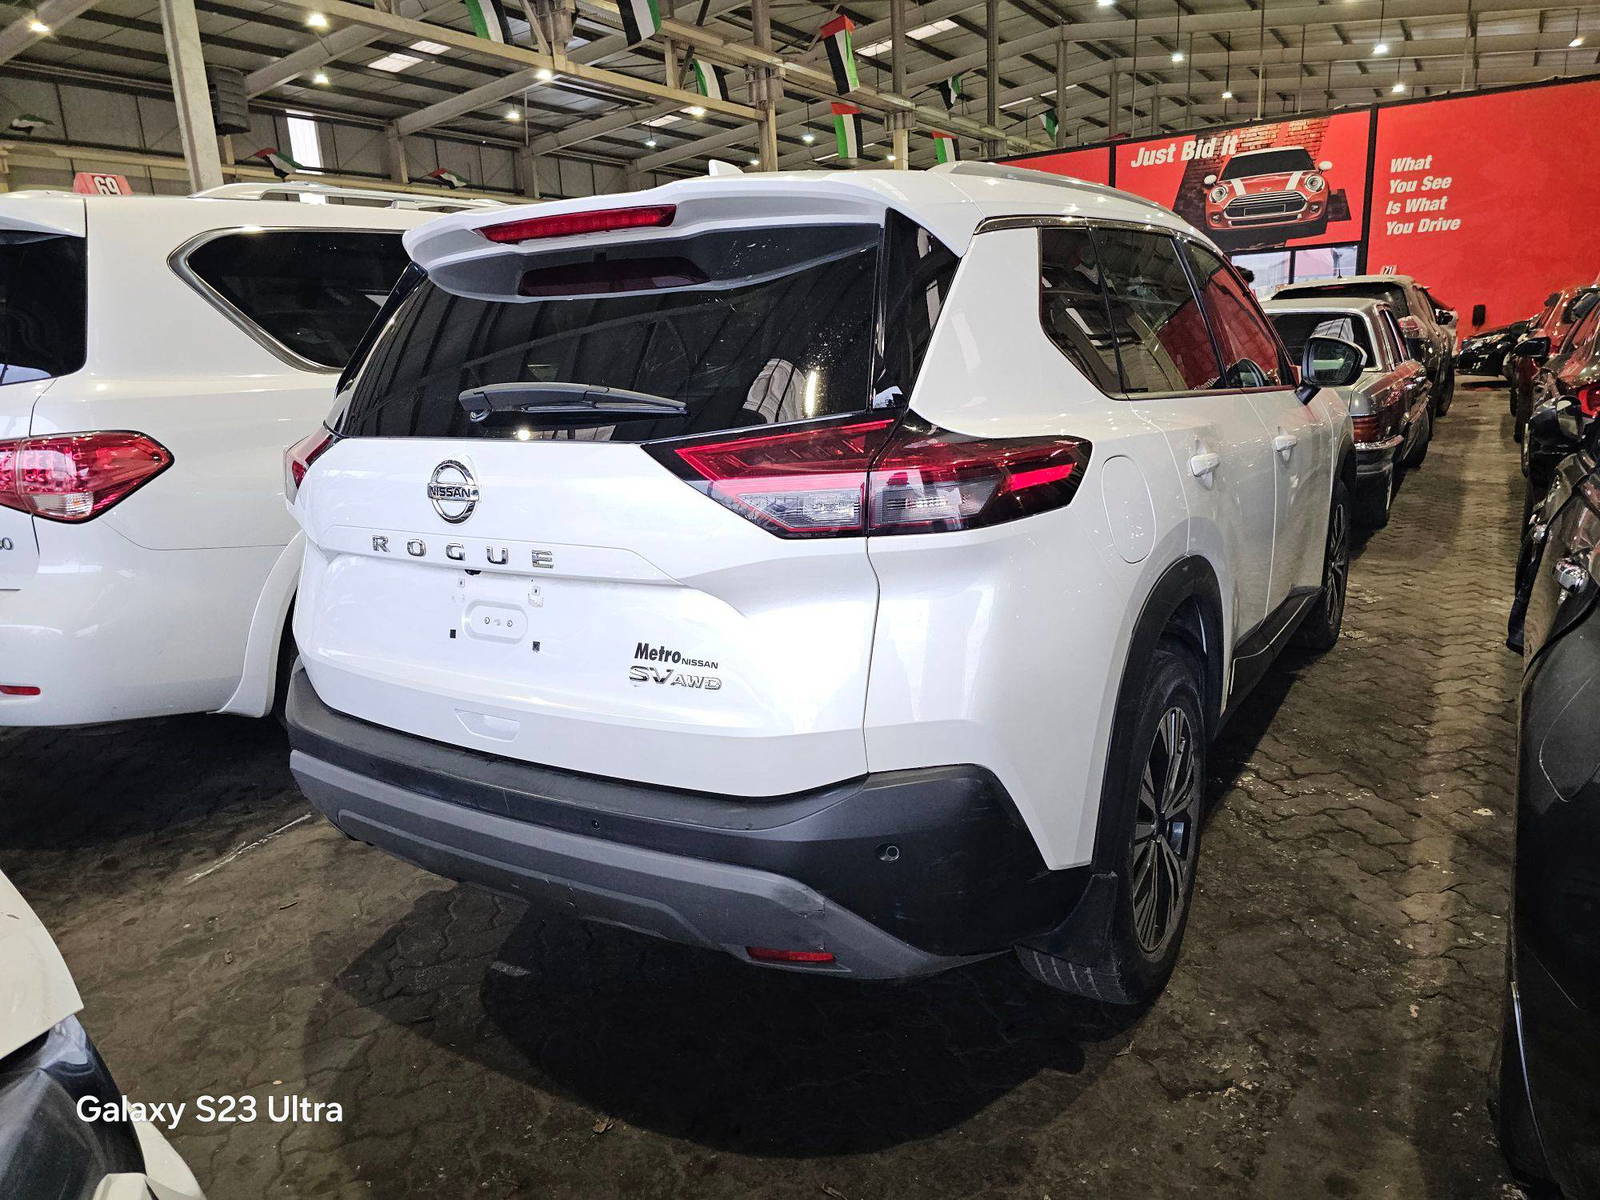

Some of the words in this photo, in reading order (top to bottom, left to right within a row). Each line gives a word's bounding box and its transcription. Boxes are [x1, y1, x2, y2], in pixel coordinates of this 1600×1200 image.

[1131, 143, 1177, 168] Just
[1181, 138, 1217, 160] Bid
[1220, 135, 1239, 156] It
[1390, 155, 1433, 173] What
[94, 176, 122, 196] 69
[1389, 179, 1418, 194] You
[1421, 176, 1453, 191] See
[1385, 200, 1402, 215] Is
[1405, 196, 1448, 213] What
[1386, 221, 1415, 235] You
[1417, 217, 1462, 233] Drive
[429, 486, 472, 499] NISSAN
[372, 535, 554, 569] ROGUE
[634, 642, 682, 663] Metro
[681, 658, 719, 669] NISSAN
[670, 674, 722, 690] AWD
